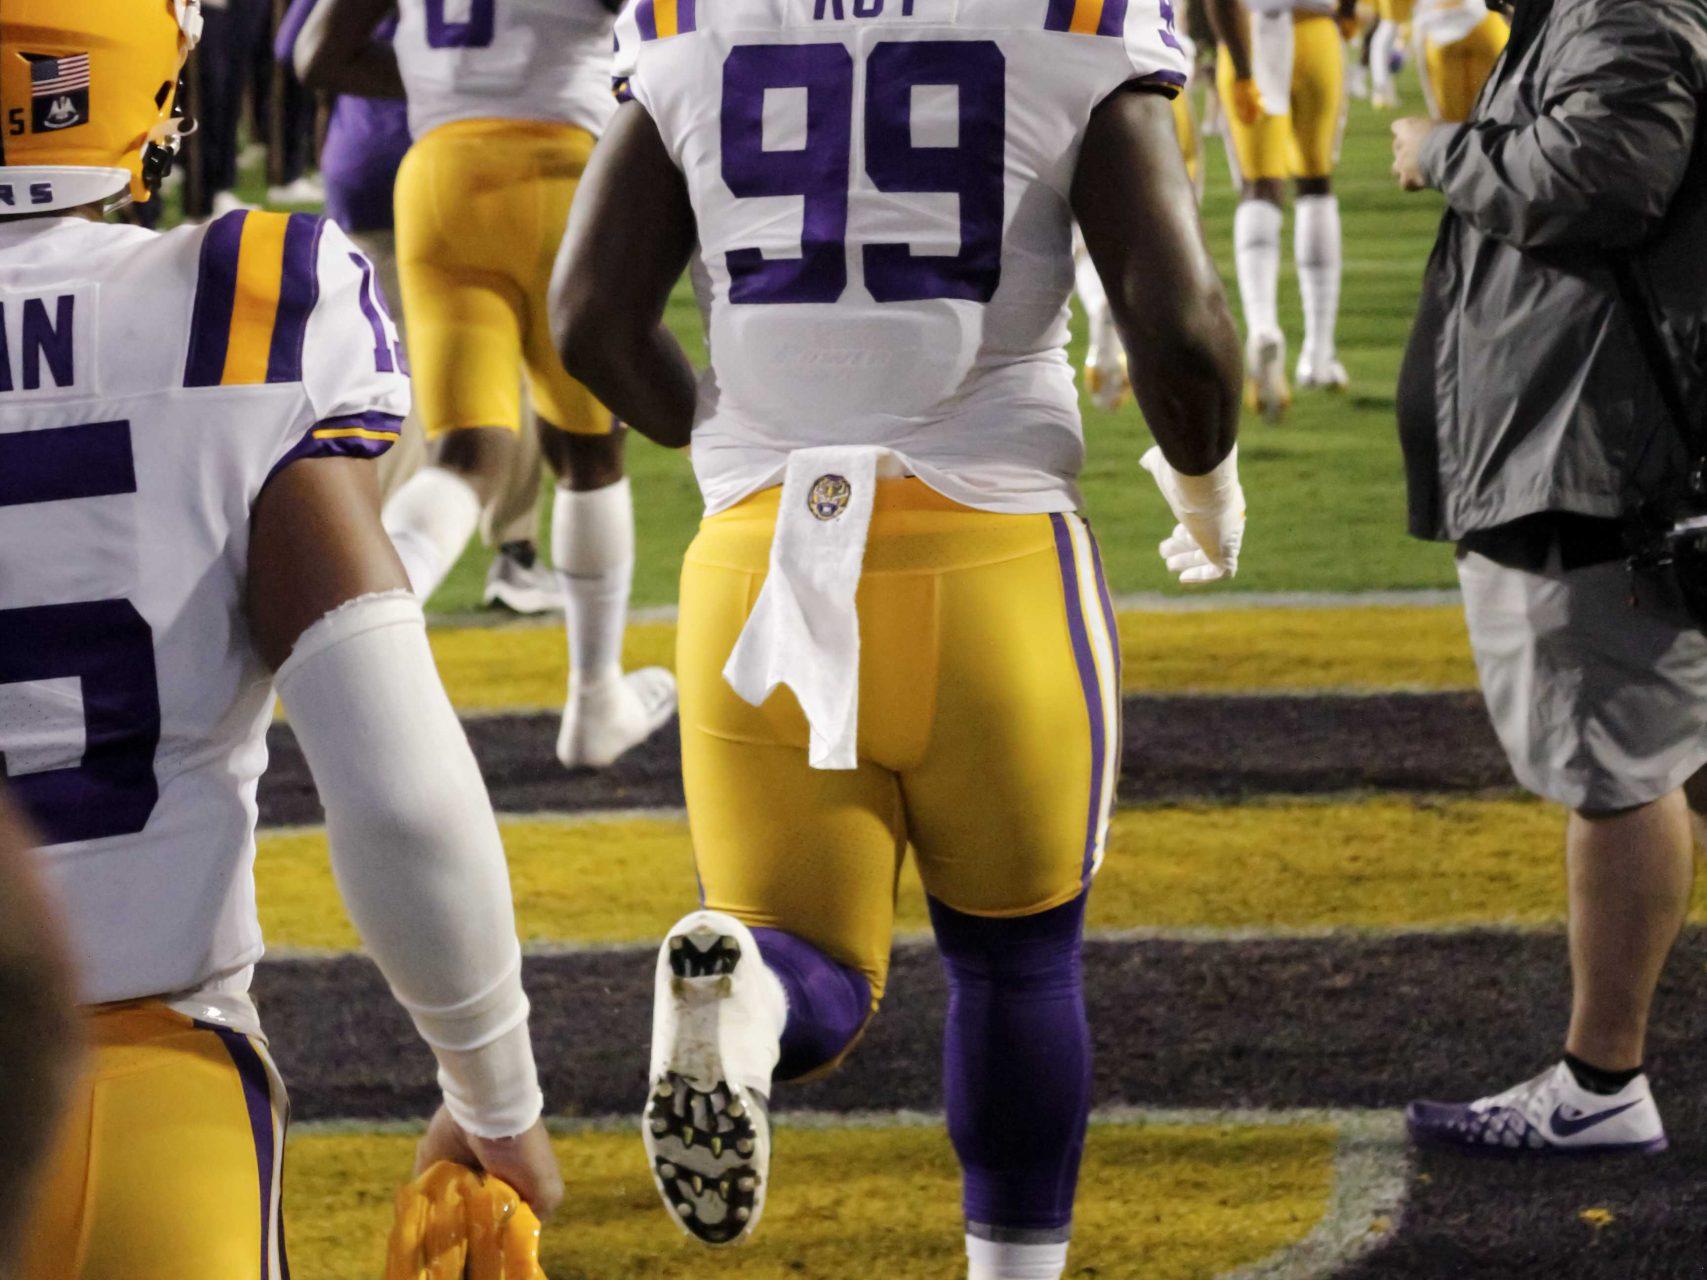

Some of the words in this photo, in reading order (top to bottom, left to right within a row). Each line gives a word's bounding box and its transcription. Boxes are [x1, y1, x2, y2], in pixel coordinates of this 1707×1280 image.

[9, 108, 25, 136] 5
[720, 39, 1006, 306] 99
[0, 294, 74, 391] N
